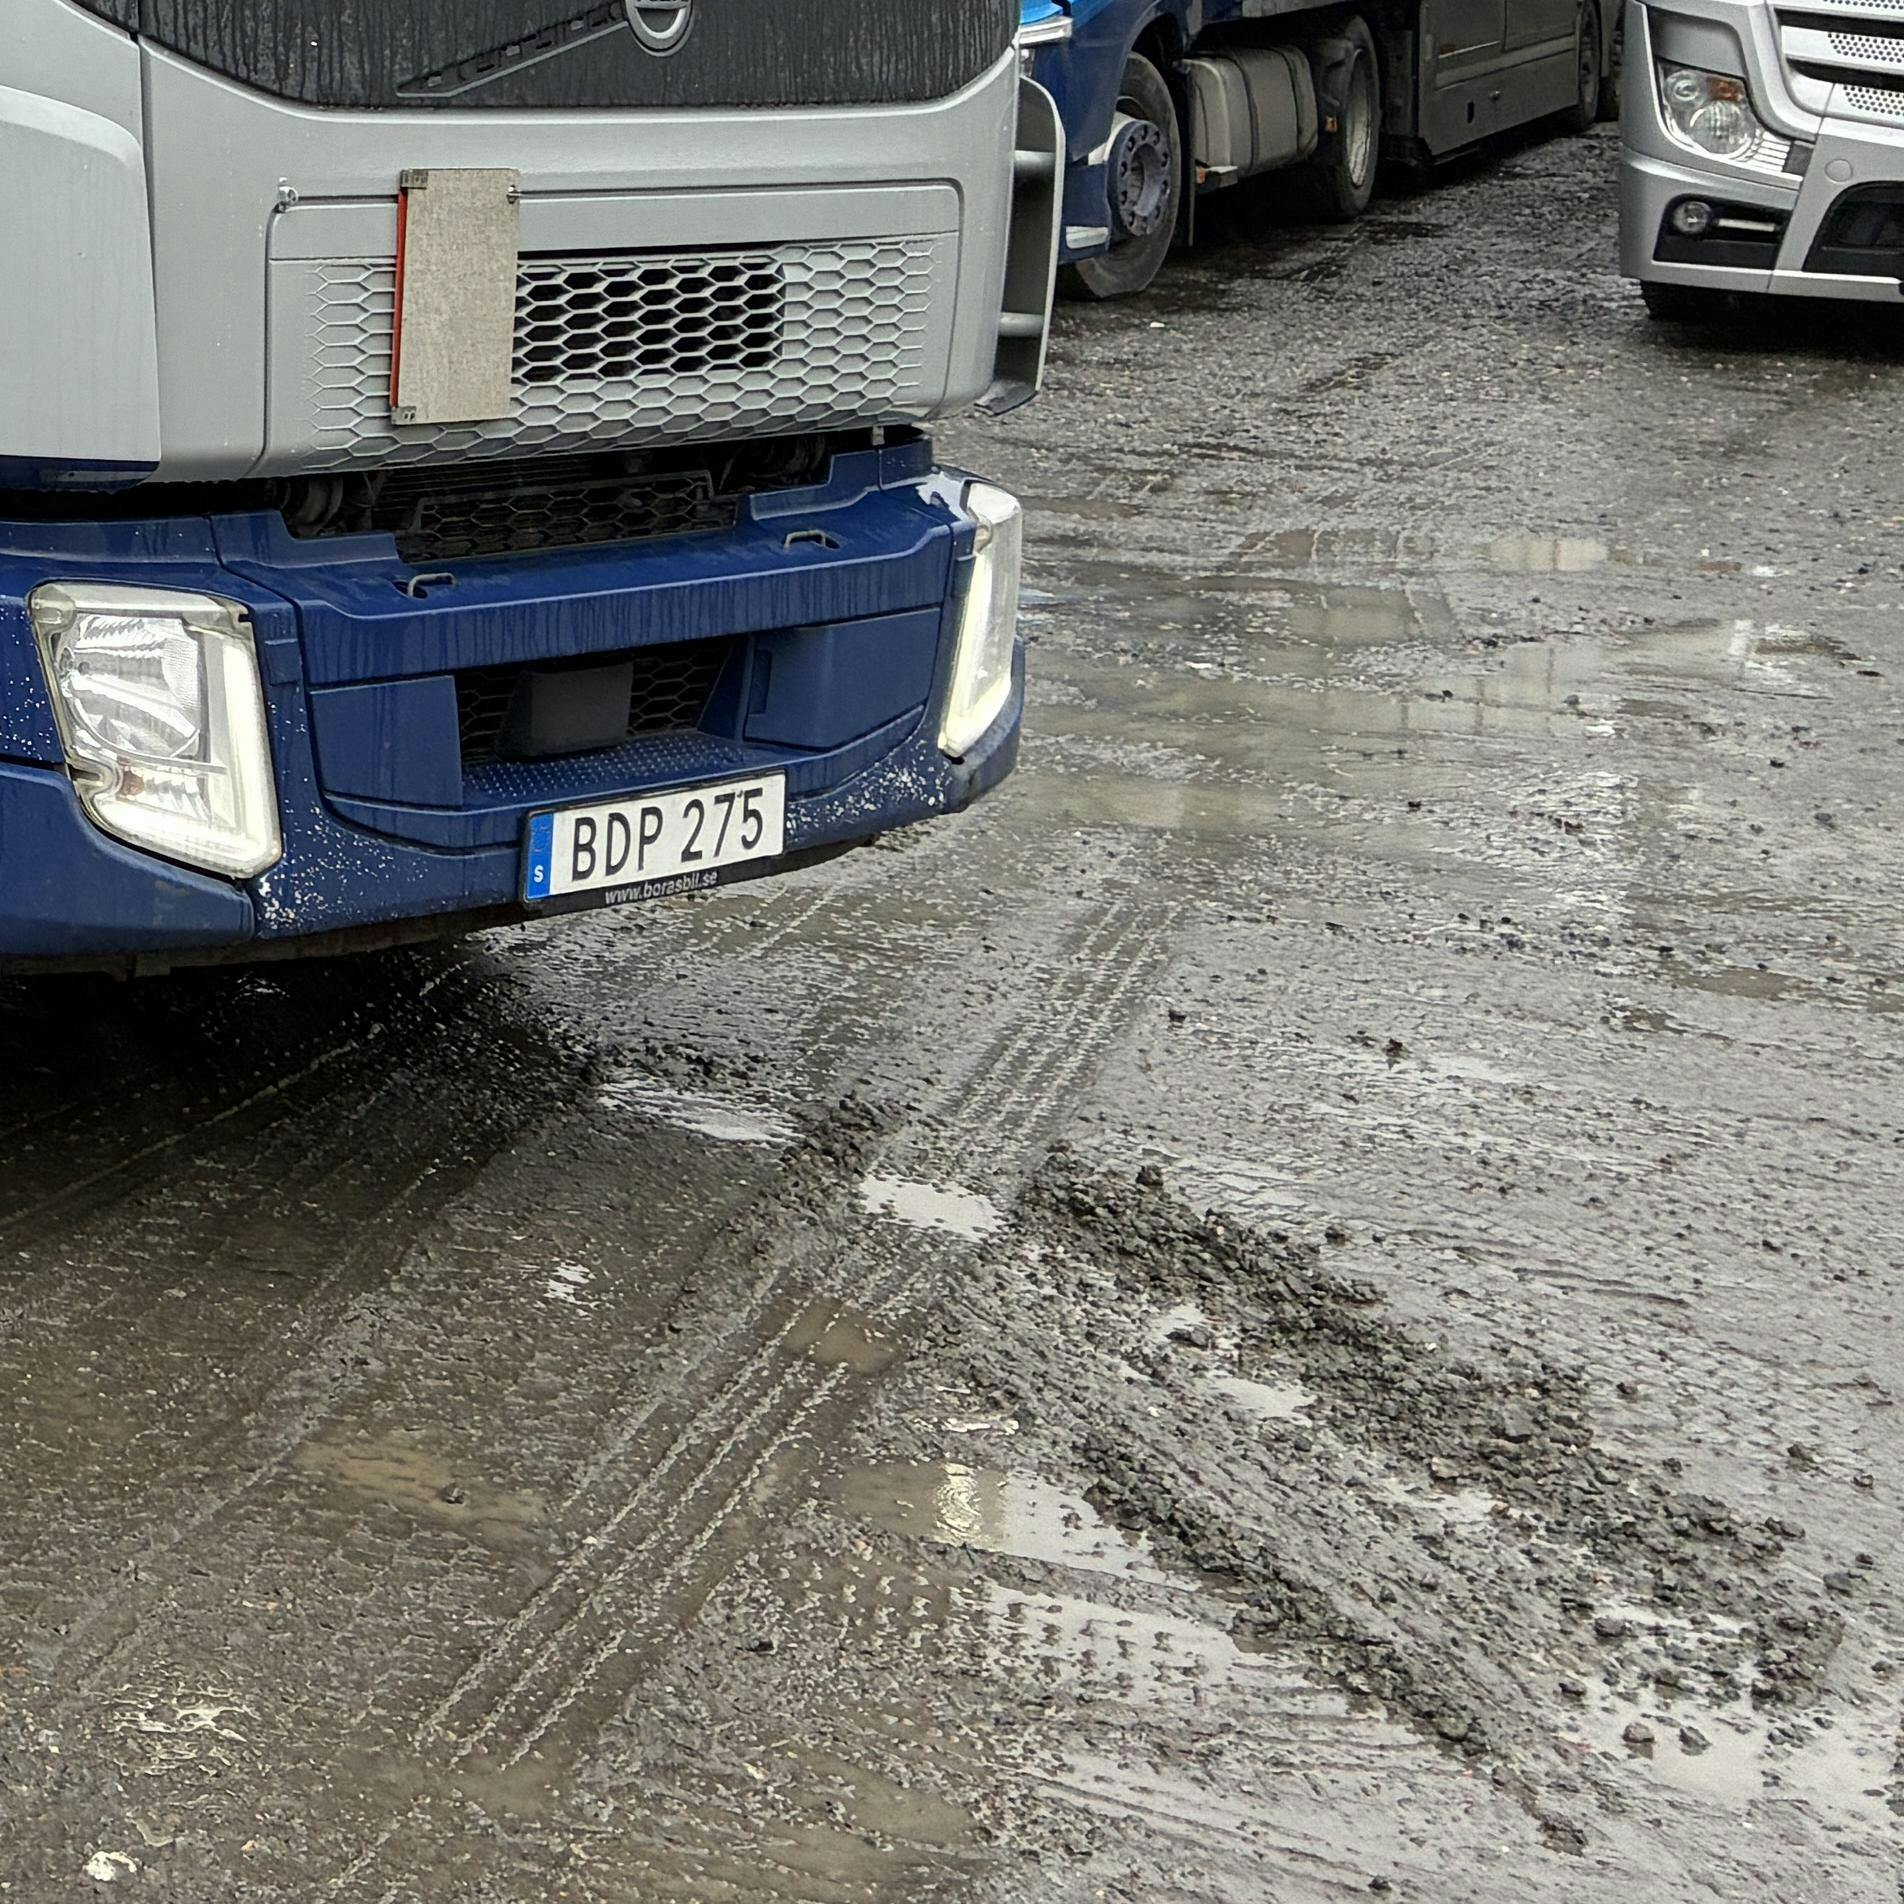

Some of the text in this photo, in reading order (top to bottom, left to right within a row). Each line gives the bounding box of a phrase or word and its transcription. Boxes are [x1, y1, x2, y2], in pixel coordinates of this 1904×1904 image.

[571, 787, 764, 882] BDP 275
[533, 864, 545, 884] S
[604, 871, 718, 905] www.borasbil.se
